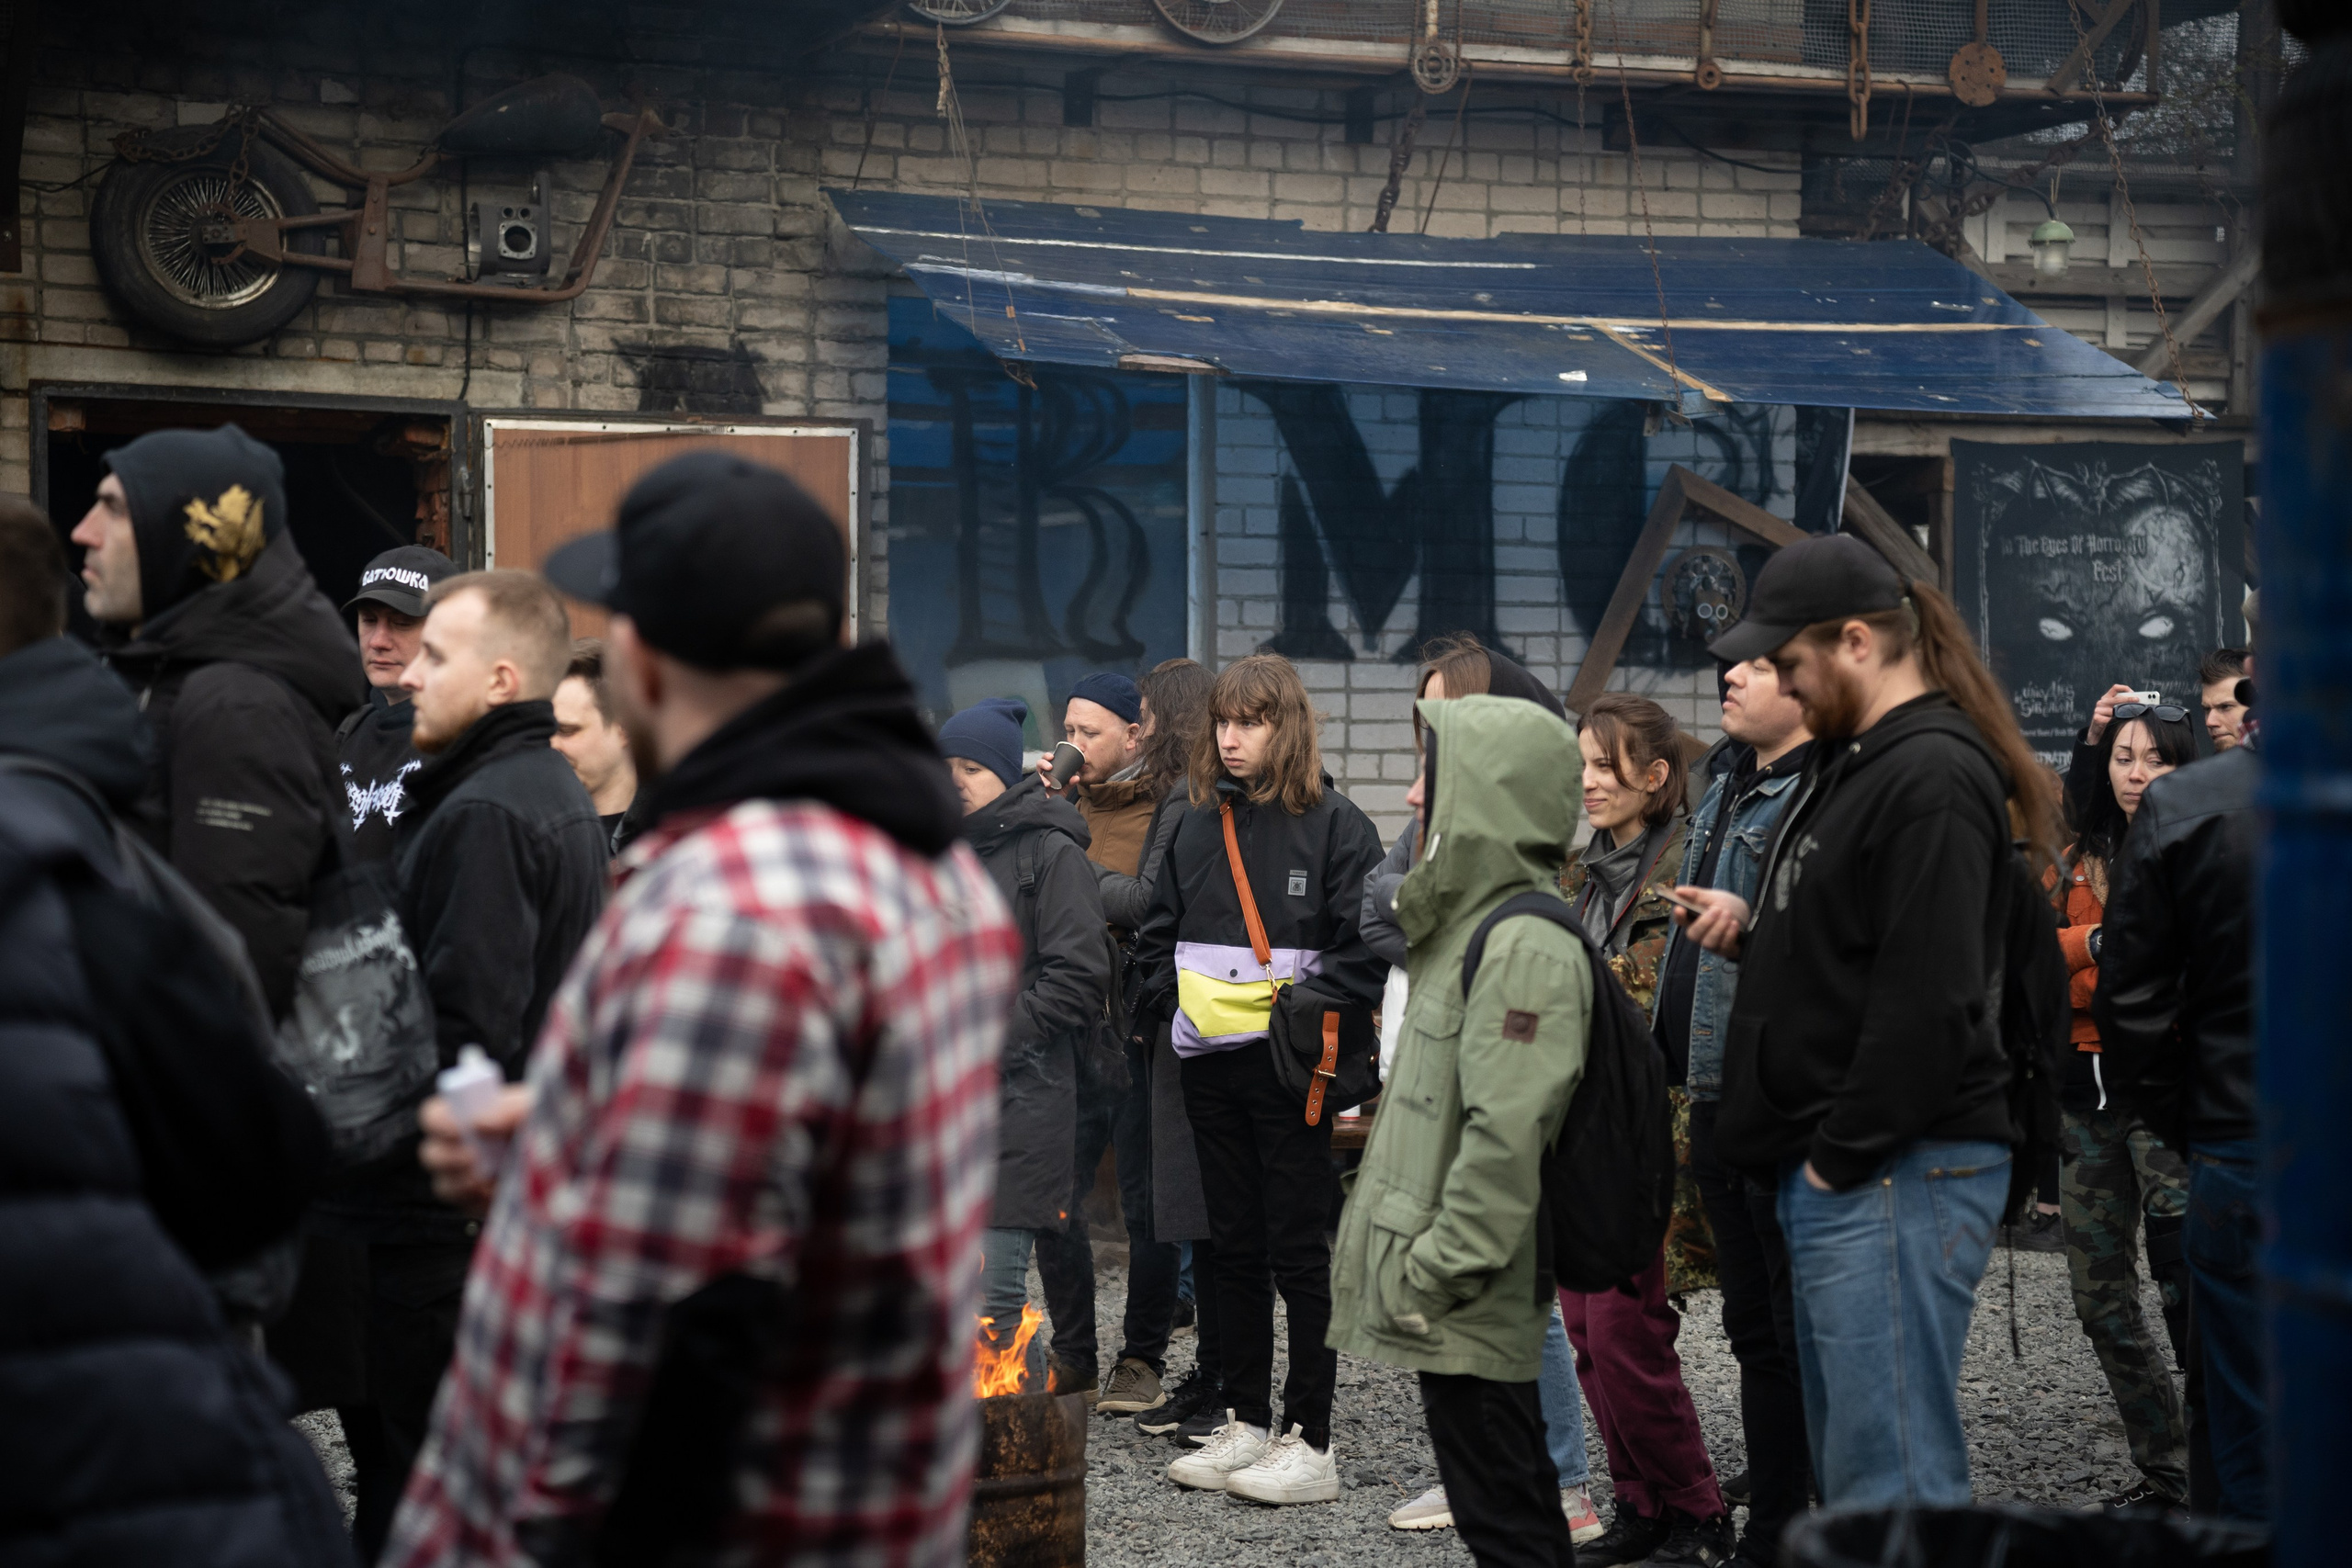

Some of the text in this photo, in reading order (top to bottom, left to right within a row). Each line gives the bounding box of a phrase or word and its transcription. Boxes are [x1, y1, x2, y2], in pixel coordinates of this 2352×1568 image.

[2015, 536, 2039, 557] The
[2041, 536, 2068, 558] Eyes
[2092, 558, 2125, 583] Fest
